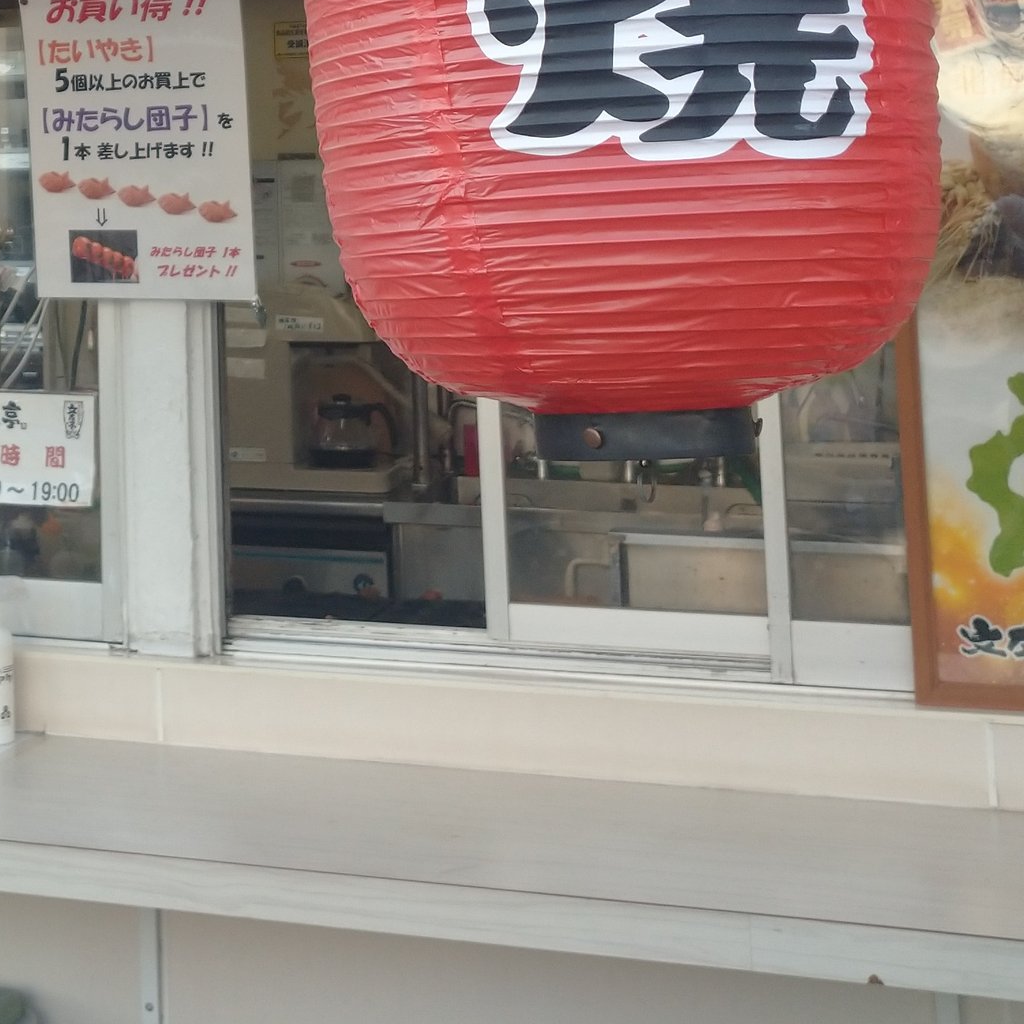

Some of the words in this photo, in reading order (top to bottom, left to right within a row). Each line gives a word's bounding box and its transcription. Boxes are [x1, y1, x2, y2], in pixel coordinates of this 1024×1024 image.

[55, 67, 206, 93] 5個以上のお買上で
